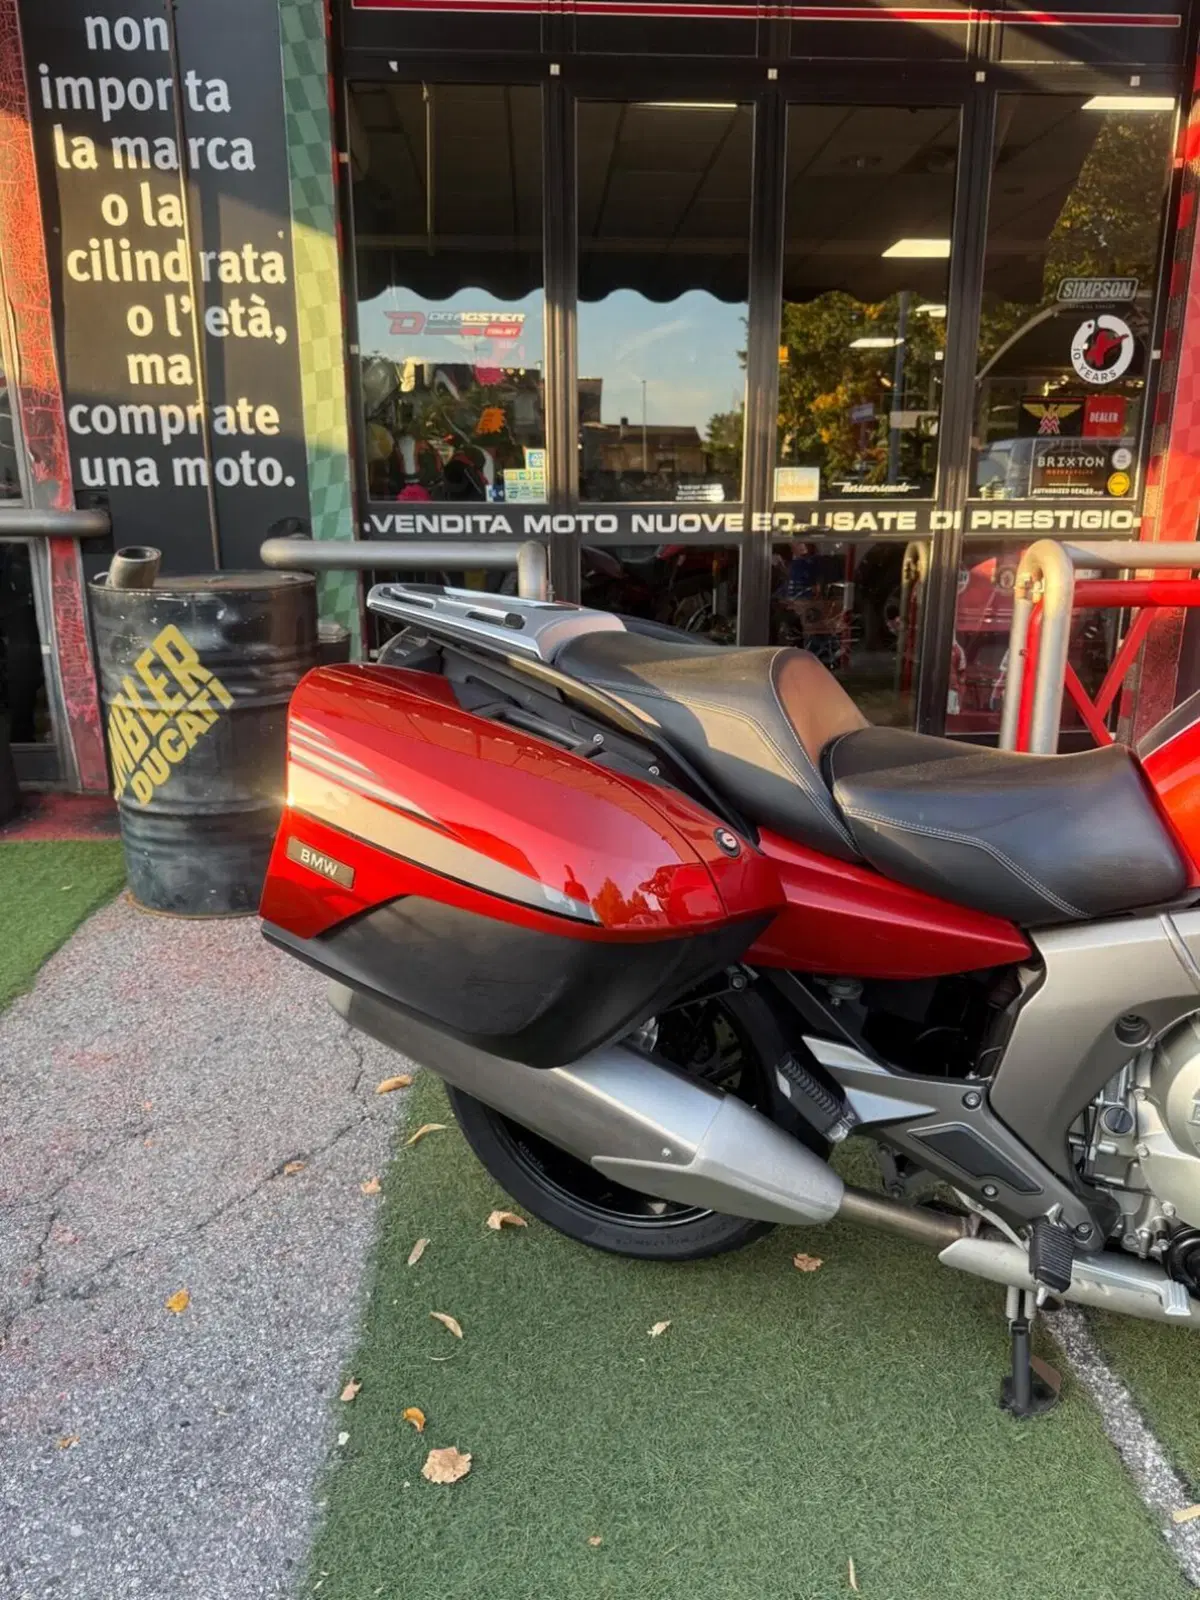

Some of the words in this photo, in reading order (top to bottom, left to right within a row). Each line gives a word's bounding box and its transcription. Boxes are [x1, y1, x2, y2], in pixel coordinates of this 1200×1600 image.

[84, 15, 169, 50] non
[38, 63, 231, 122] importa
[53, 124, 98, 169] la
[111, 136, 256, 171] marca
[101, 193, 128, 226] o
[140, 182, 184, 227] la
[67, 238, 287, 284] cilindrata
[1062, 281, 1132, 298] SIMPSON
[127, 304, 153, 337] o
[127, 352, 193, 385] ma
[1079, 364, 1116, 381] YEARS
[68, 398, 280, 445] comprate
[1089, 412, 1119, 424] DEALER
[80, 456, 160, 487] una
[172, 451, 295, 487] moto.
[1037, 456, 1105, 468] BRIXTON
[370, 514, 512, 534] VENDITA
[524, 514, 618, 533] MOTO
[632, 513, 743, 533] NUOVE
[810, 511, 917, 531] USATE
[930, 511, 961, 530] DI
[107, 624, 214, 801] MBLER
[130, 677, 235, 806] DUCATI
[300, 848, 338, 876] BMW
